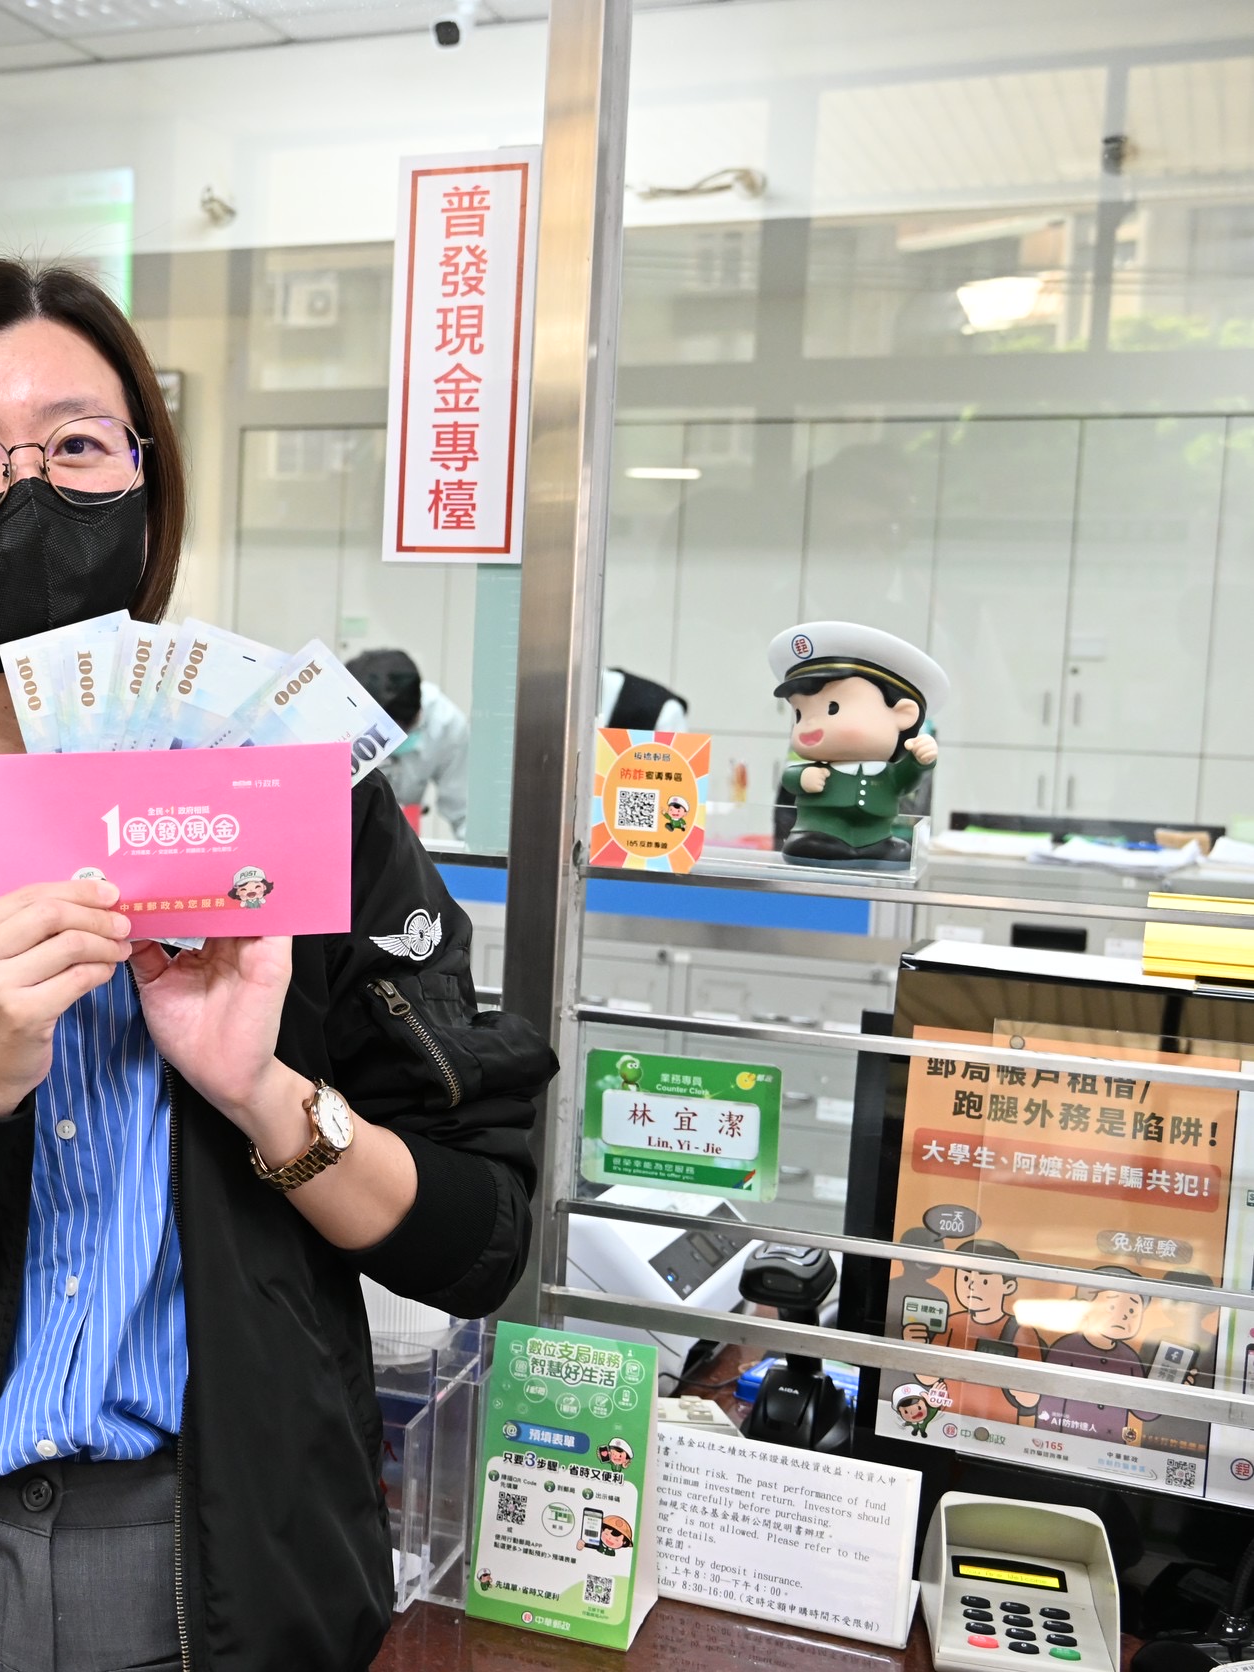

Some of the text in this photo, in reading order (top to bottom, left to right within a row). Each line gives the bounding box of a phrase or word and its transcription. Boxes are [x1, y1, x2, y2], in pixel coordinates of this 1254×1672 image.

[428, 185, 491, 531] 普發現金專檯
[178, 638, 208, 695] 1000
[16, 656, 42, 711] 1000
[77, 650, 95, 707] 1000
[274, 660, 323, 706] 1000
[255, 779, 280, 788] 行政院
[128, 820, 234, 842] 普發現金
[239, 870, 257, 879] POST
[119, 898, 225, 912] 中華郵政為您服務
[656, 1084, 687, 1094] Counter
[660, 1073, 702, 1086] 業務專員
[627, 1102, 744, 1138] 林宜潔
[952, 1090, 1219, 1147] 跑腿外務是陷阱!
[647, 1136, 673, 1150] Lin,
[703, 1143, 722, 1155] Jie
[612, 1157, 695, 1175] 很榮幸能為您服務
[940, 1219, 965, 1232] 2000
[941, 1210, 963, 1221] 一天
[1110, 1233, 1177, 1258] 免經驗
[527, 1339, 621, 1369] 數位支局服務
[530, 1358, 615, 1387] 智慧好生活
[529, 1428, 575, 1448] 預填表單
[960, 1428, 1006, 1445] 中郵政
[1045, 1440, 1063, 1451] 165
[1106, 1452, 1138, 1463] 中華郵政
[523, 1478, 537, 1486] Code
[664, 1461, 887, 1512] without risk. The past performance of fund
[662, 1474, 891, 1526] minimum investment return. Investors should
[687, 1492, 734, 1509] carefully
[739, 1500, 771, 1515] before
[775, 1510, 832, 1528] purchasing.
[677, 1528, 716, 1544] details.
[685, 1516, 694, 1525] is
[699, 1520, 714, 1529] not
[720, 1524, 759, 1540] allowed.
[767, 1532, 800, 1548] Please
[804, 1542, 832, 1554] refer
[838, 1548, 848, 1558] to
[854, 1551, 870, 1562] the
[695, 1556, 705, 1568] by
[710, 1560, 747, 1576] deposit
[753, 1569, 803, 1588] insurance.
[534, 1616, 571, 1632] 中華郵政
